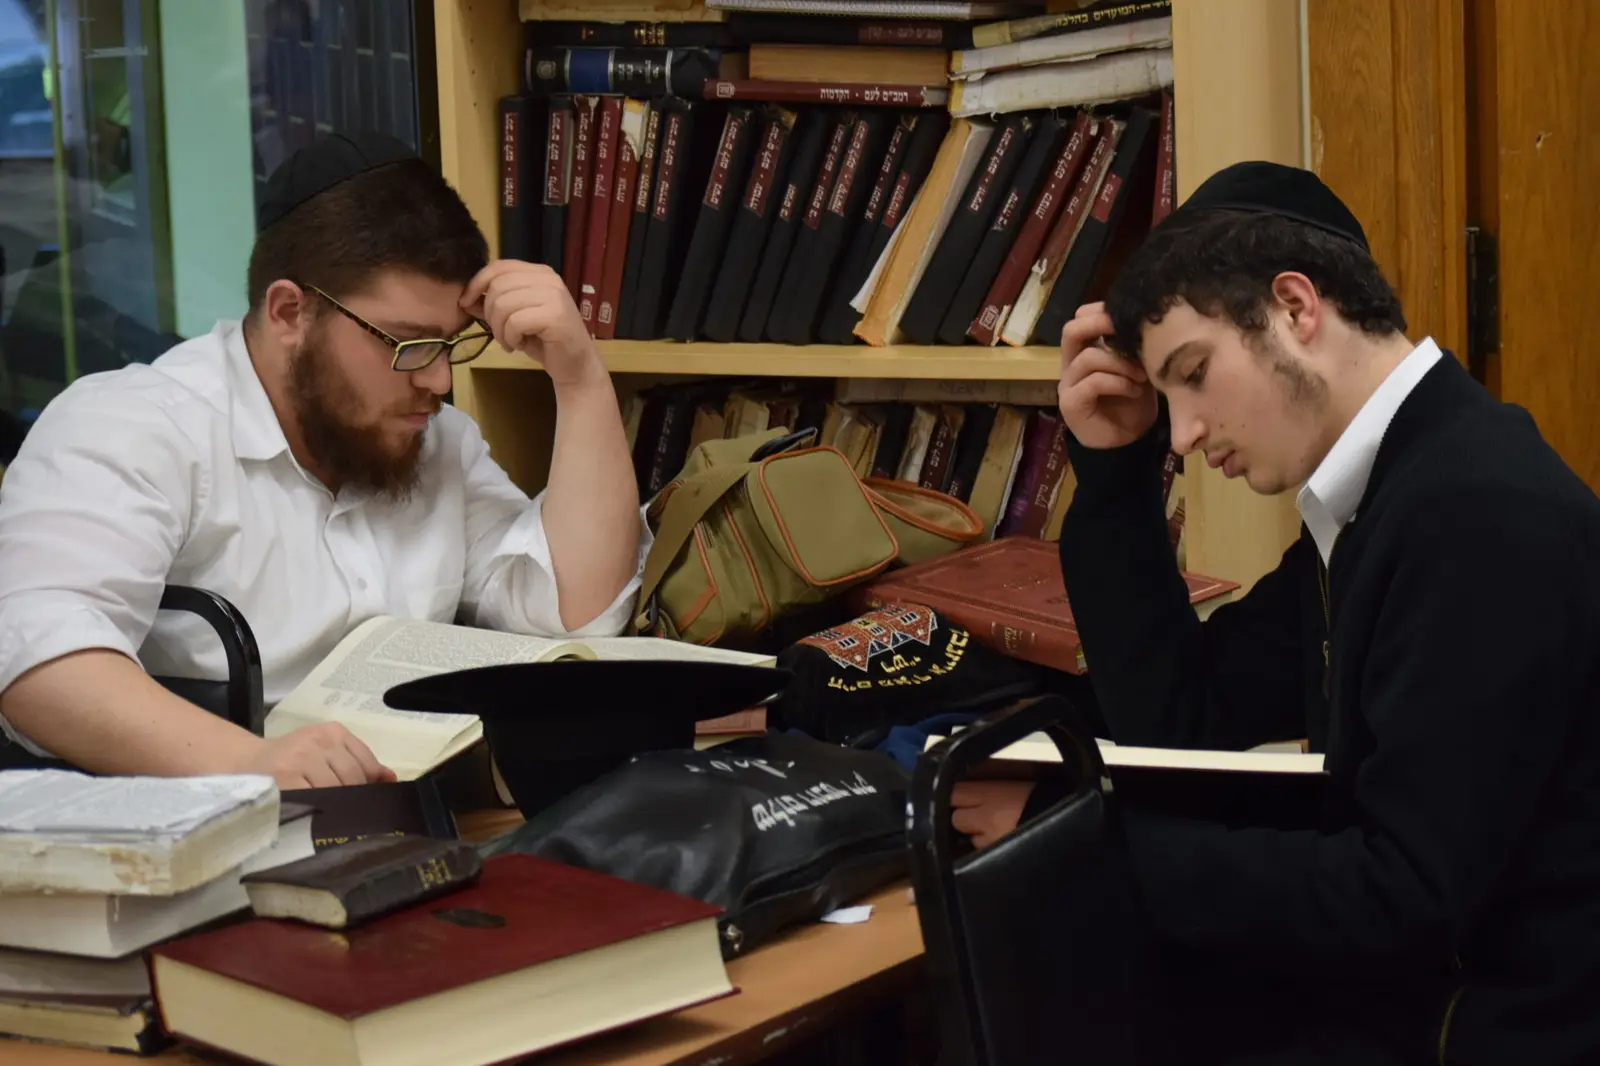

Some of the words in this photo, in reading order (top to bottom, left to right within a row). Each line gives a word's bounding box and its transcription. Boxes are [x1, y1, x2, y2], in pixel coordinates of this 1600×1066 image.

[820, 88, 850, 102] הקדמות
[864, 86, 880, 101] לעם
[504, 146, 514, 162] לעם
[550, 144, 559, 160] לעם
[576, 144, 586, 161] לעם
[598, 141, 608, 159] לעם
[644, 142, 654, 159] לעם
[664, 148, 674, 166] לעם
[846, 149, 858, 169] לעם
[720, 150, 731, 169] לעם
[761, 150, 772, 170] לעם
[824, 154, 835, 171] לעם
[986, 157, 999, 176] לעם
[1054, 161, 1067, 180] לעם
[1082, 164, 1094, 184] לעם
[711, 183, 722, 204] נשים
[813, 186, 826, 208] זמנים
[828, 676, 872, 692] חיים
[878, 674, 932, 688] מאיר
